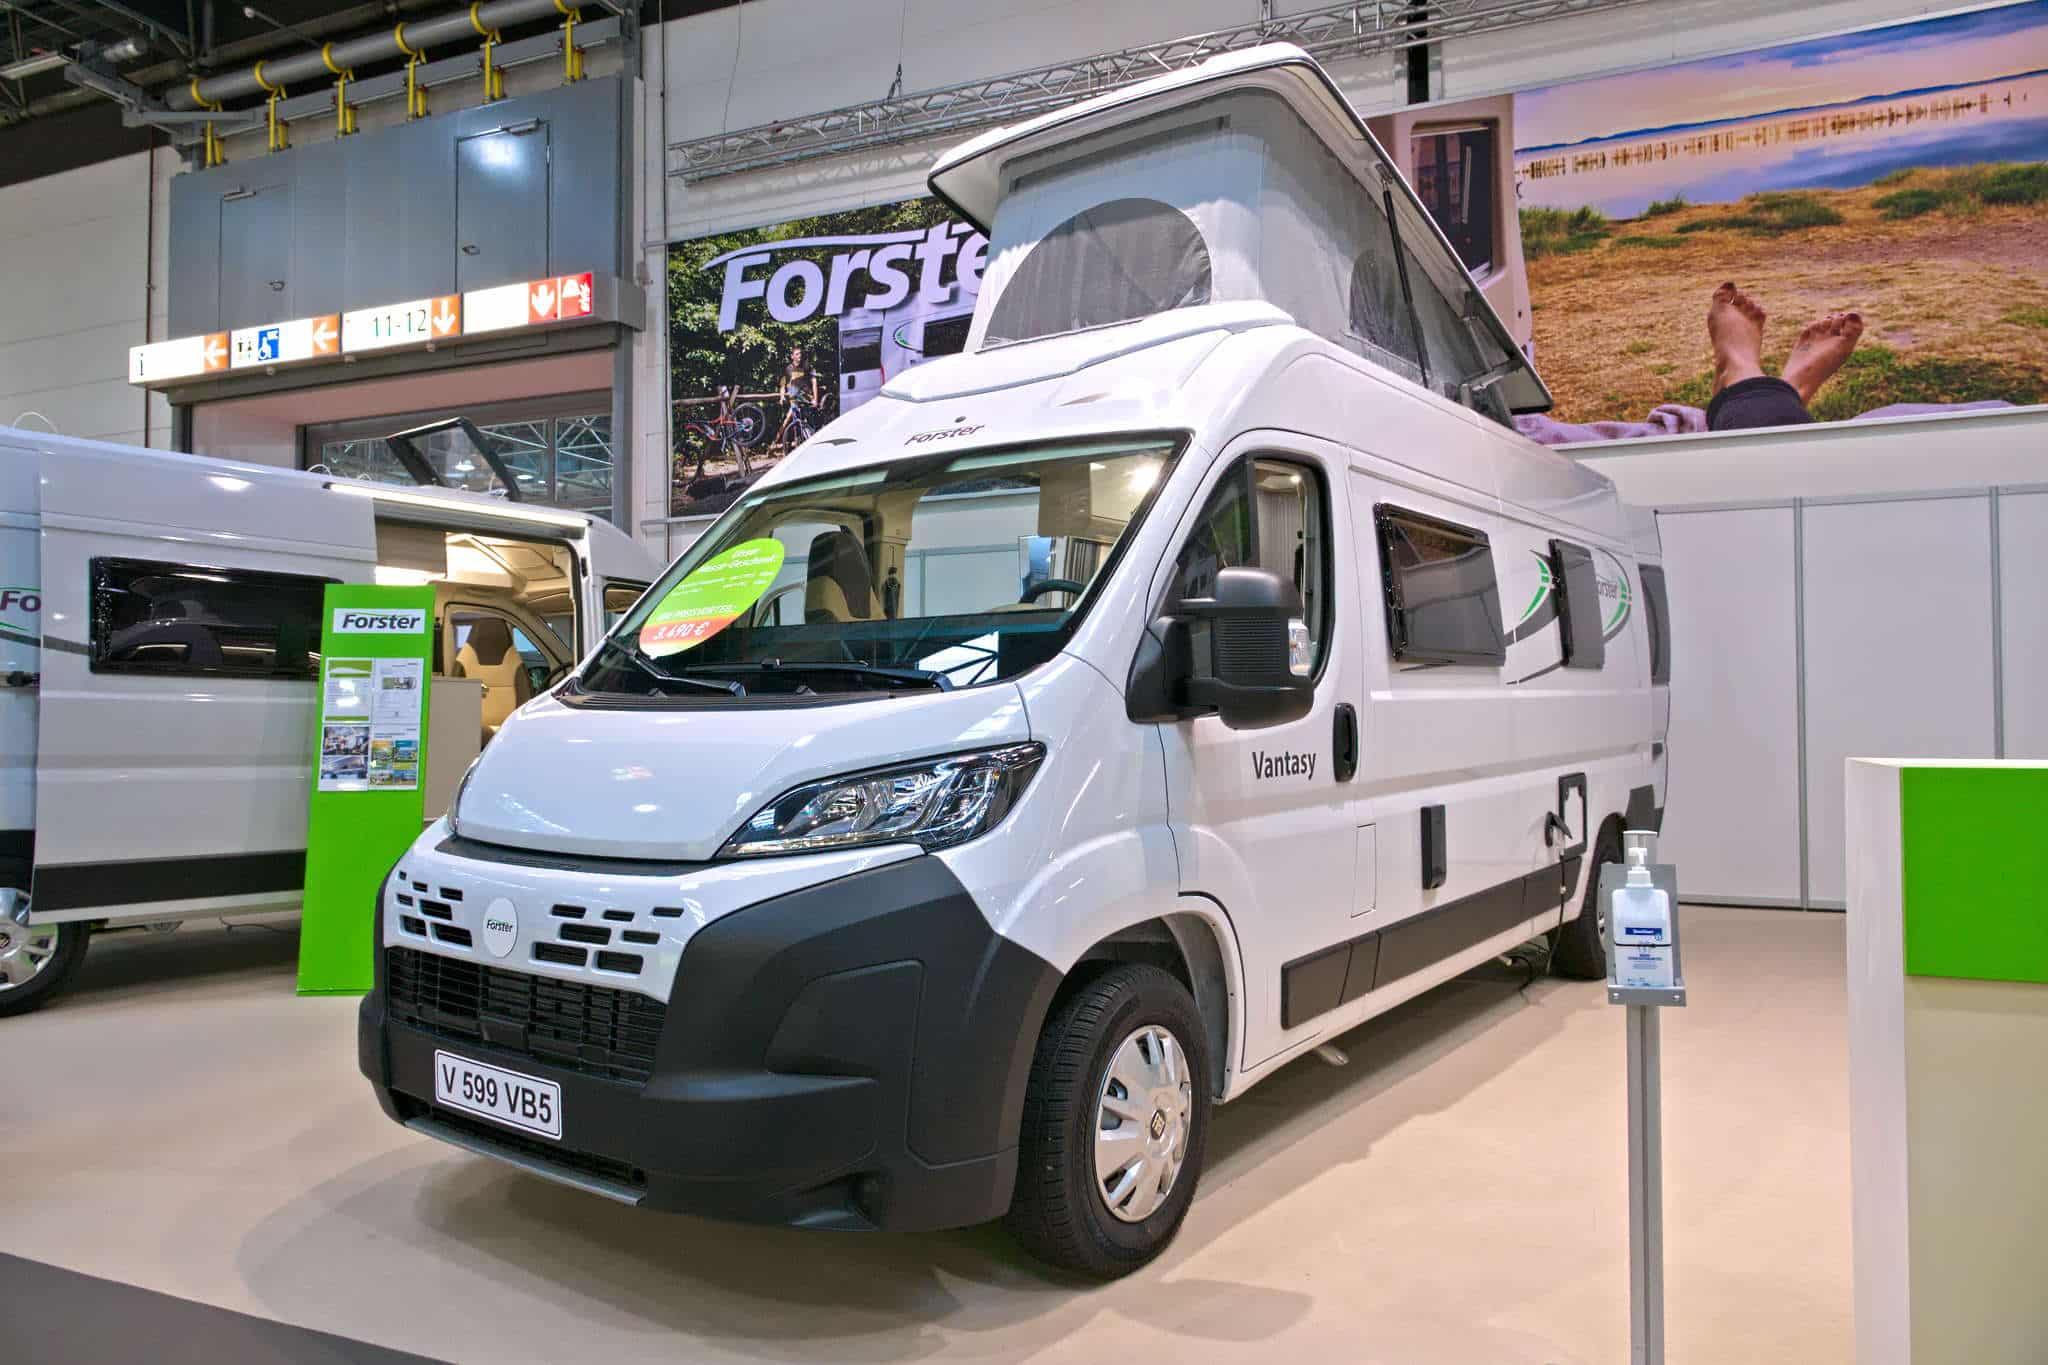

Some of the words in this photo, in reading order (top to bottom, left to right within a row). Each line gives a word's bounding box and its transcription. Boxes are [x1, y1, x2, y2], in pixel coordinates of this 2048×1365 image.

[373, 309, 428, 338] 11-12
[904, 424, 985, 446] Forster
[342, 614, 420, 630] Forster
[1252, 750, 1317, 781] Vantasy
[486, 919, 513, 933] Forster
[442, 1063, 456, 1094] V
[463, 1071, 498, 1108] 599
[504, 1082, 552, 1124] VB5
